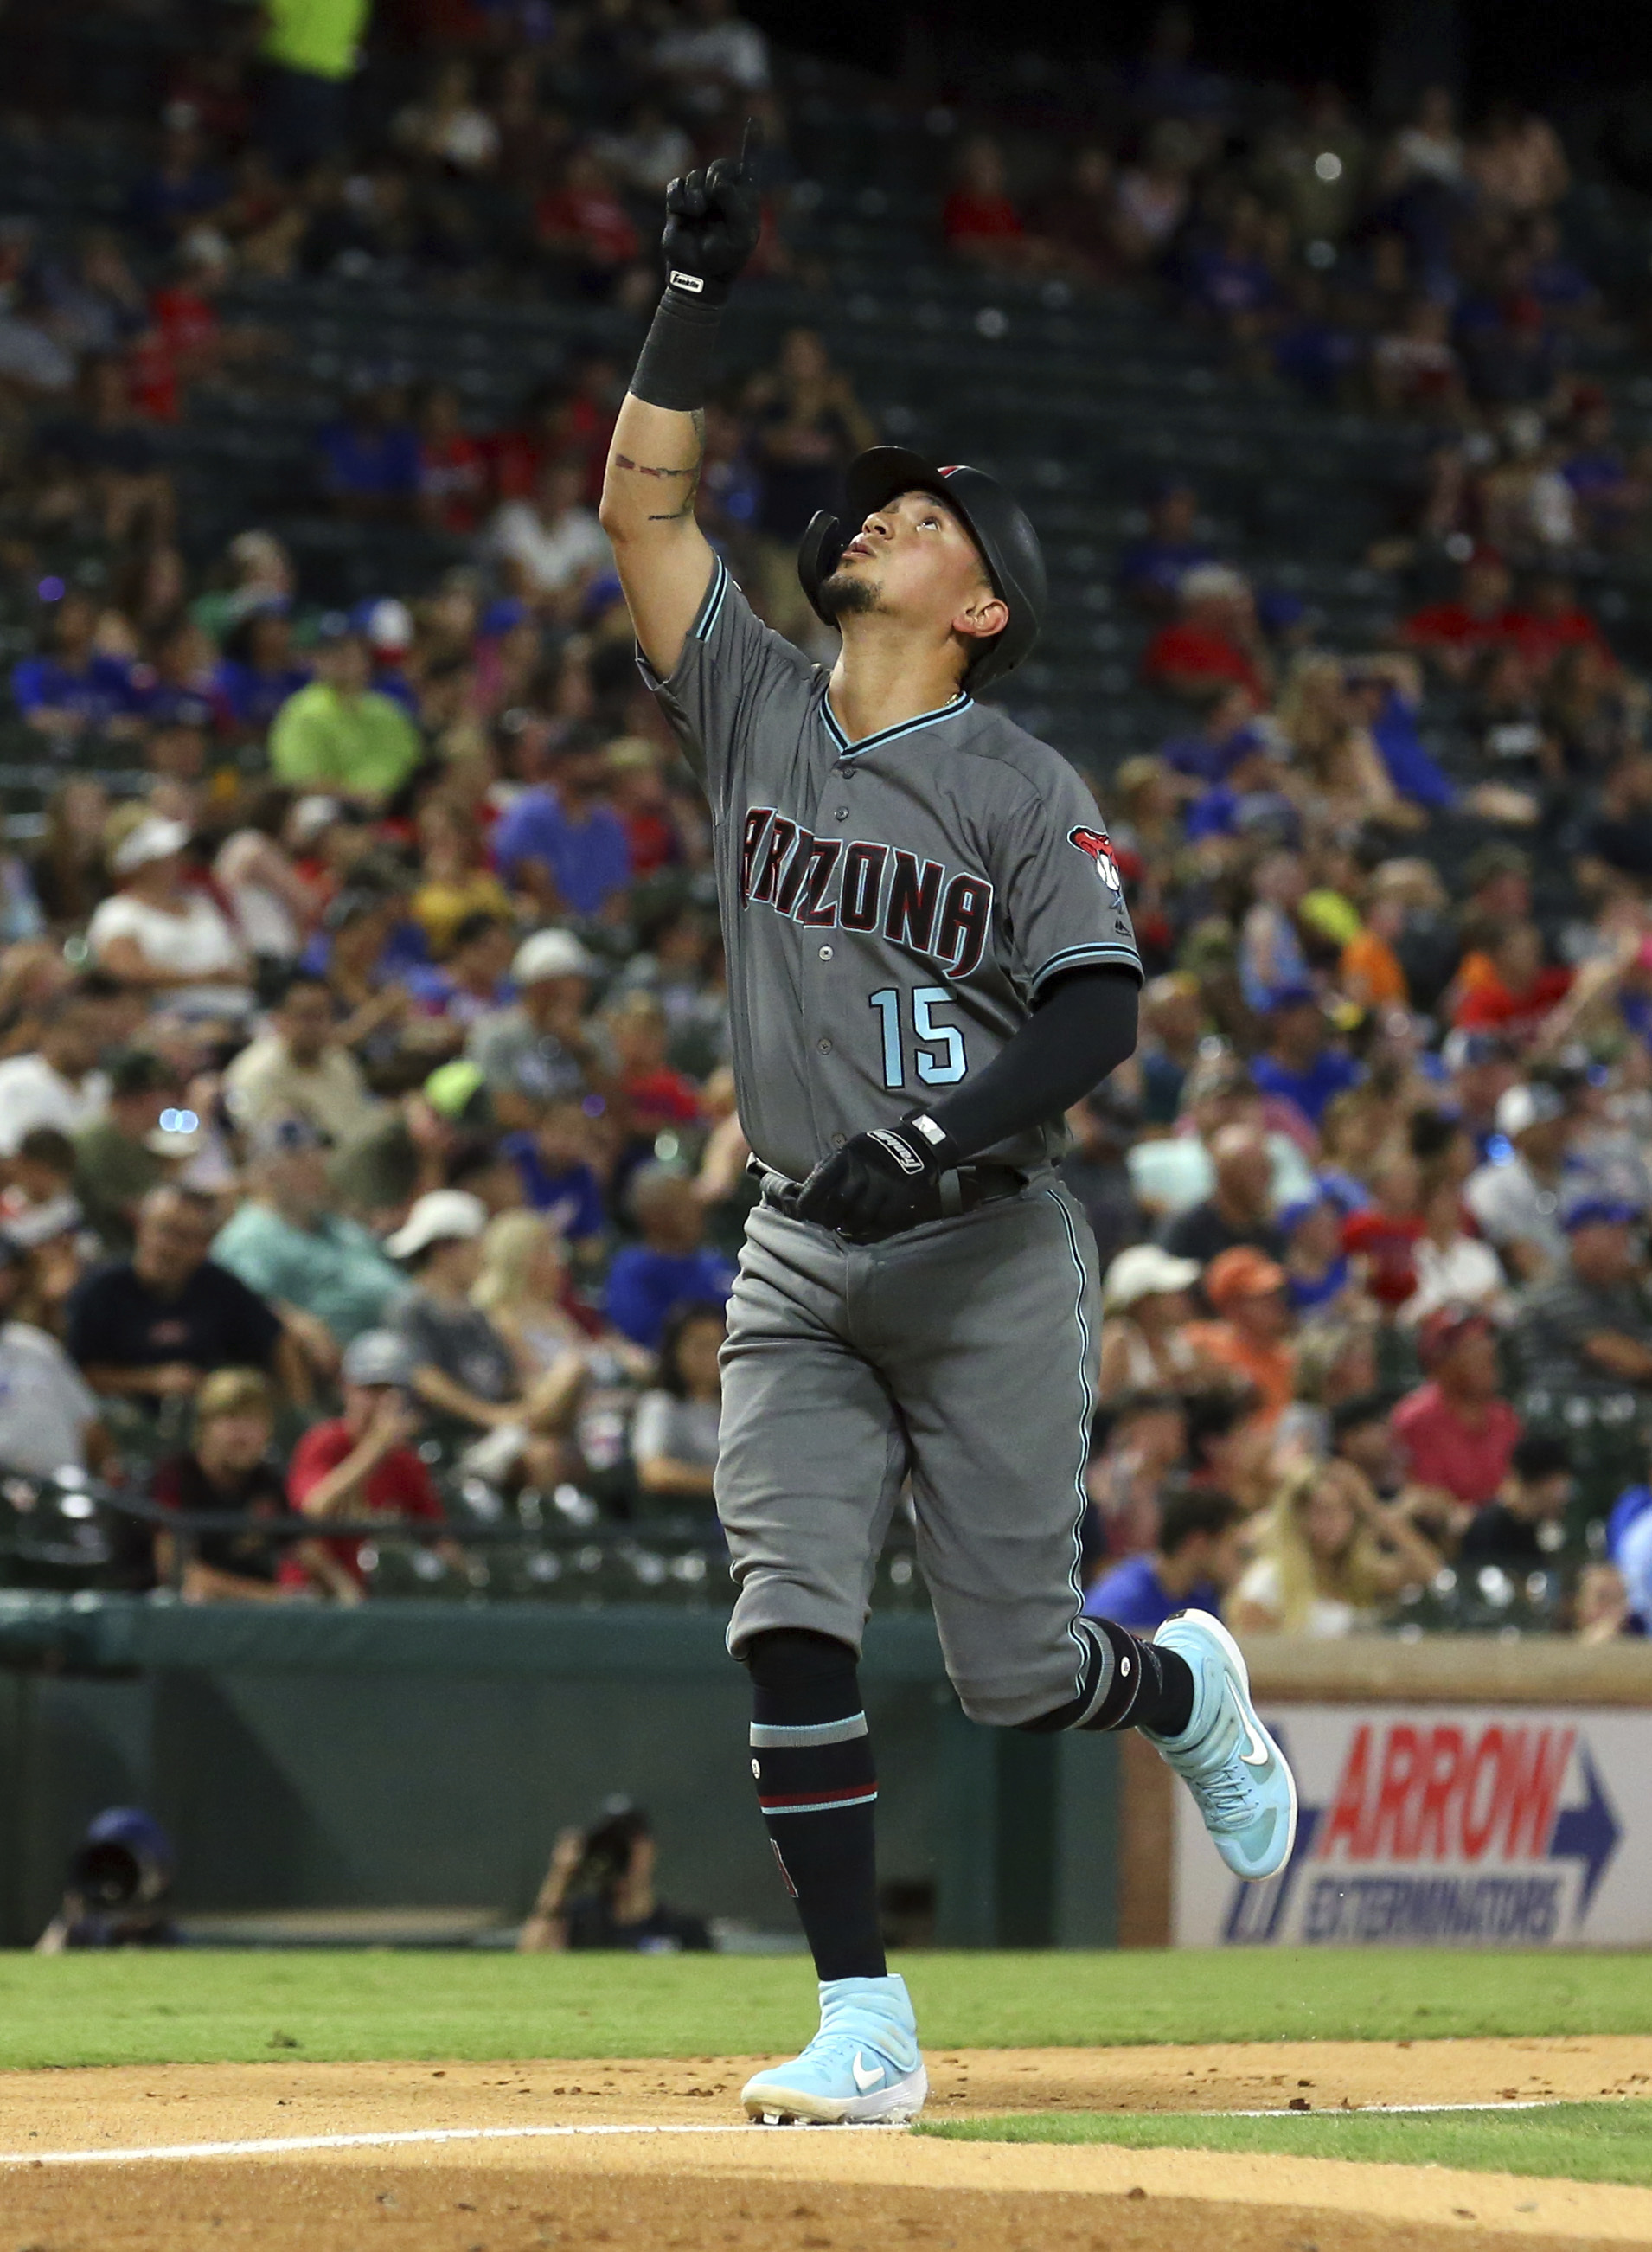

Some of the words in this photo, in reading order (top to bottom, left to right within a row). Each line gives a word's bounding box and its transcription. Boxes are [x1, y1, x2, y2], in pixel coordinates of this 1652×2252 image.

[741, 806, 993, 979] ARIZONA
[868, 985, 968, 1089] 15
[1316, 1723, 1576, 1861] ARROW
